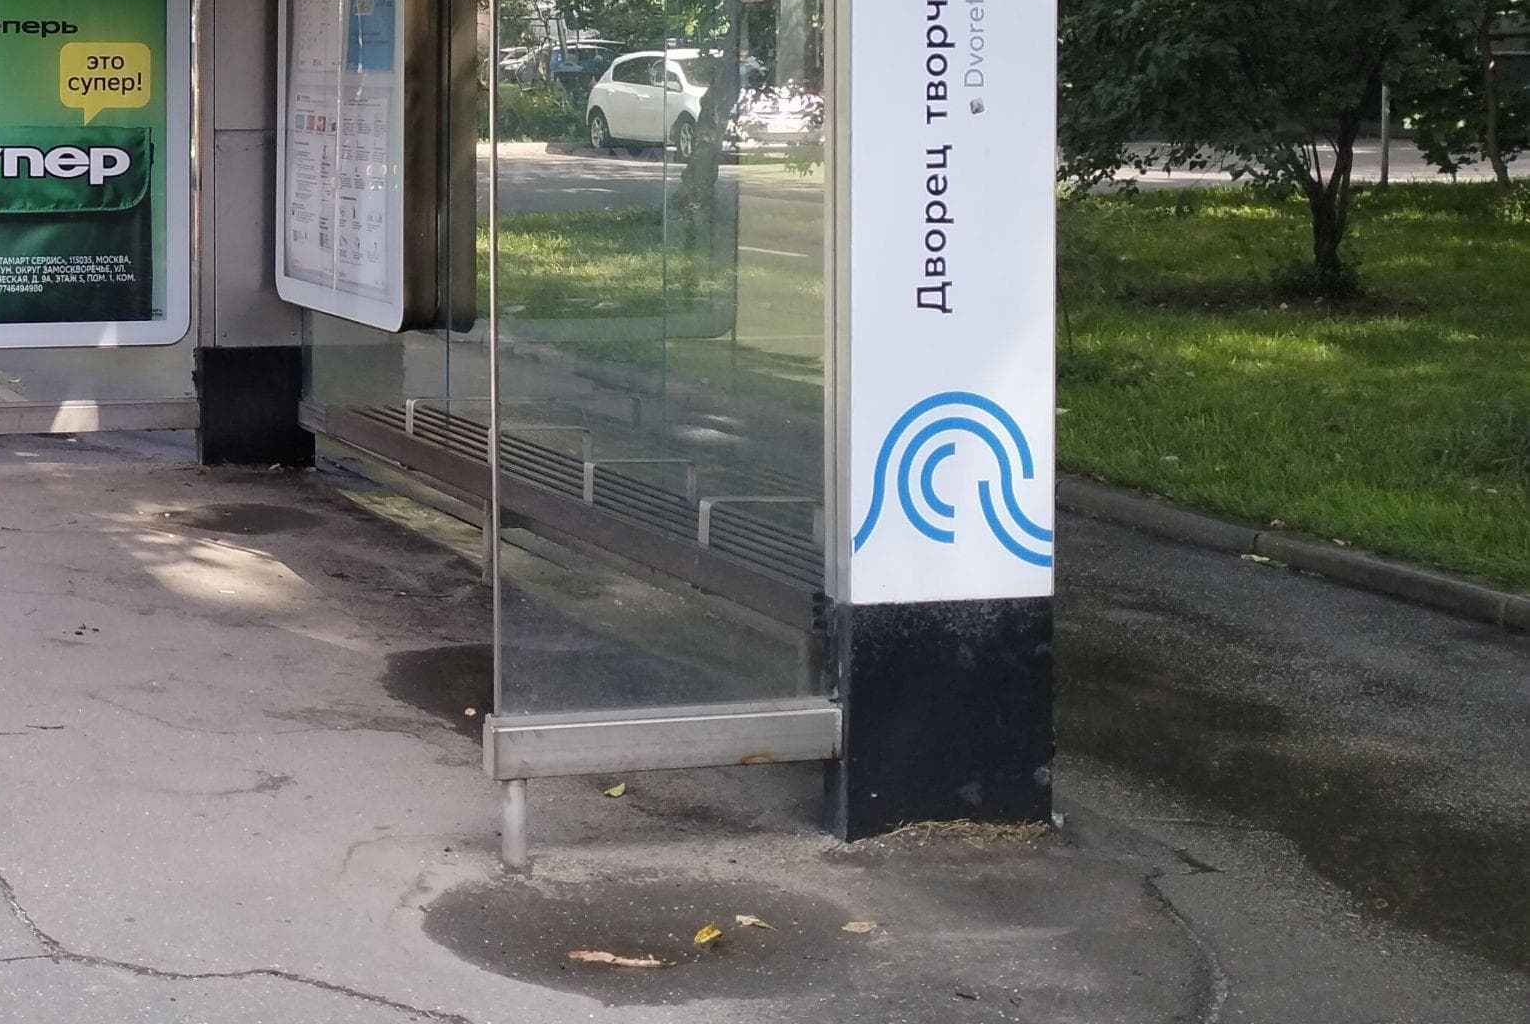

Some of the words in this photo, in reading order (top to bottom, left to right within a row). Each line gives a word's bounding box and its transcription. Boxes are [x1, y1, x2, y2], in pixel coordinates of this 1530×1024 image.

[86, 55, 125, 71] это
[67, 73, 143, 94] супер!
[917, 144, 954, 314] Дворец
[15, 266, 41, 274] ОКРУГ
[55, 275, 78, 283] ЭТАЖ
